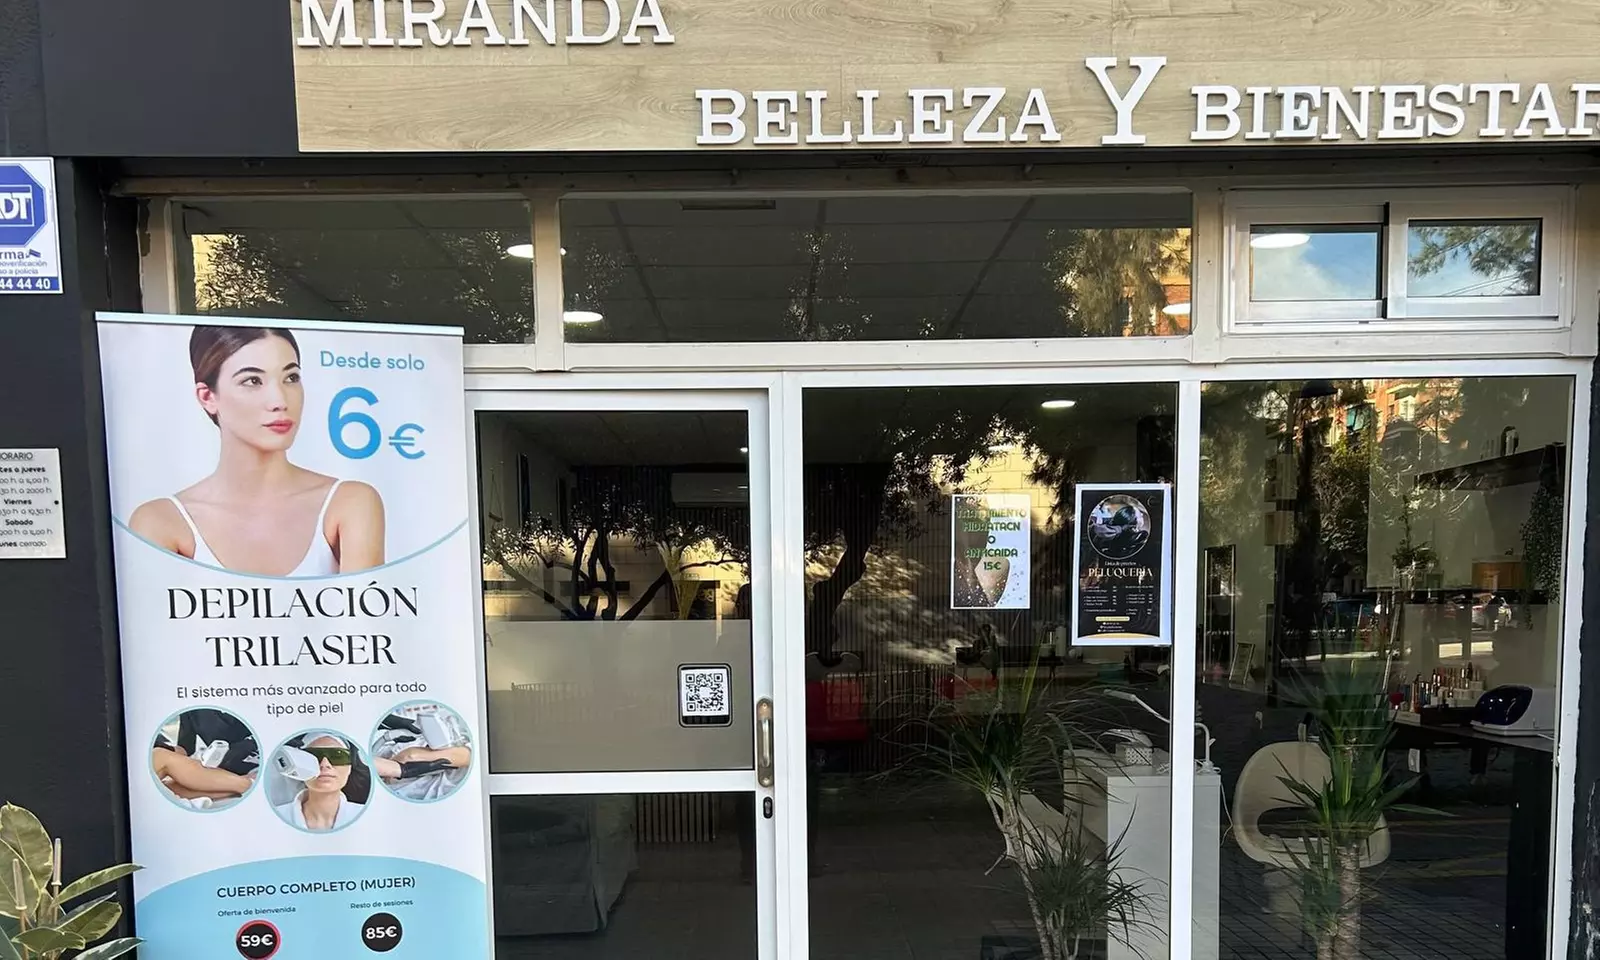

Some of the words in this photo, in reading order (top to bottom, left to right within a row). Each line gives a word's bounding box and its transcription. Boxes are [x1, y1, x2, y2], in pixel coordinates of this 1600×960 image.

[297, 0, 674, 47] MIRANDA
[695, 87, 1061, 144] BELLEZA
[1085, 56, 1167, 145] Y
[17, 278, 32, 289] 44
[36, 278, 50, 289] 40
[320, 350, 382, 368] Desde
[387, 353, 425, 371] solo
[22, 466, 46, 474] jueves
[987, 535, 996, 544] O
[983, 561, 1002, 571] 15€
[167, 581, 418, 619] DEPILACIÓN
[205, 634, 397, 667] TRILASER
[177, 686, 188, 698] El
[191, 685, 248, 698] sistema
[252, 684, 284, 697] más
[287, 682, 356, 696] avanzado
[360, 684, 392, 698] para
[395, 681, 427, 694] todo
[267, 703, 294, 718] tipo
[297, 702, 315, 715] de
[319, 702, 344, 717] piel
[216, 884, 276, 899] CUERPO
[280, 880, 357, 895] COMPLETO
[360, 876, 416, 892] (MUJER)
[217, 909, 242, 917] Oferta
[243, 908, 253, 916] de
[254, 906, 297, 915] bienvenida
[350, 902, 371, 910] Resto
[383, 899, 414, 908] sesiones
[365, 925, 398, 940] 85€
[240, 933, 274, 948] 59€
